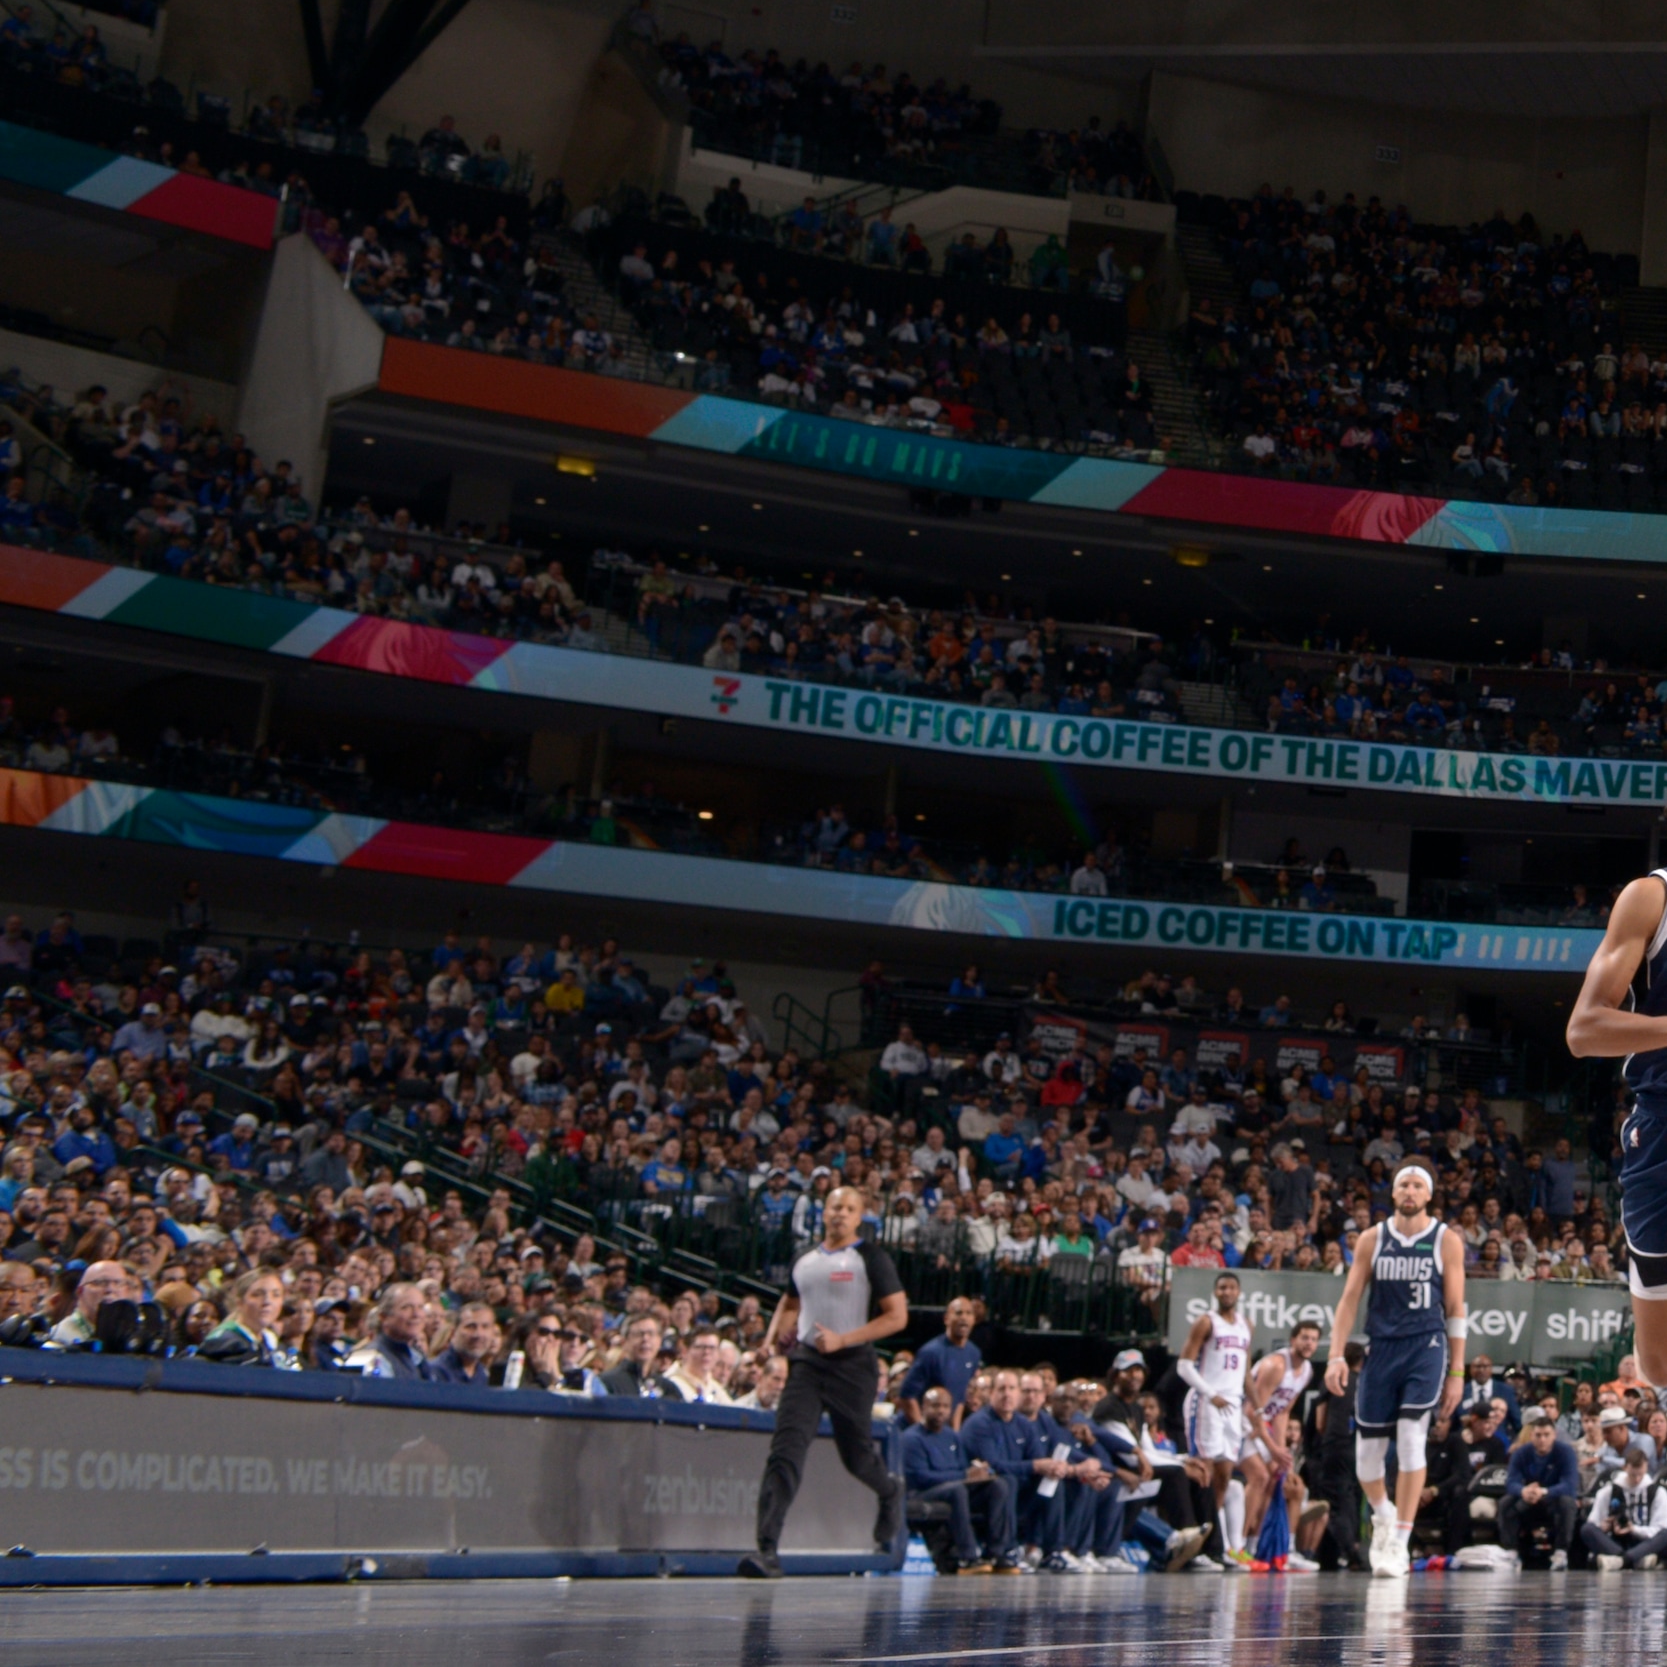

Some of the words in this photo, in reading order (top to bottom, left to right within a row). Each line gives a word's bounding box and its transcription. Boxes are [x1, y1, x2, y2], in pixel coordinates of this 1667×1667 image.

[765, 681, 845, 731] THE
[854, 695, 1040, 753] OFFICIAL
[1051, 720, 1210, 767] COFFEE
[1219, 735, 1273, 772] OF
[1280, 741, 1358, 780] THE
[1369, 748, 1527, 794] DALLAS
[1054, 900, 1149, 940] ICED
[1157, 909, 1309, 952] COFFEE
[1317, 918, 1375, 956] ON
[1382, 922, 1457, 960] TAP
[1376, 1256, 1433, 1281] MAVS
[1408, 1283, 1431, 1309] 31
[1223, 1354, 1239, 1370] 19
[40, 1450, 68, 1490] IS
[76, 1450, 281, 1494] COMPLICATED.
[286, 1458, 327, 1494] WE
[333, 1459, 400, 1497] MAKE
[405, 1463, 427, 1495] IT
[431, 1465, 493, 1499] EASY.
